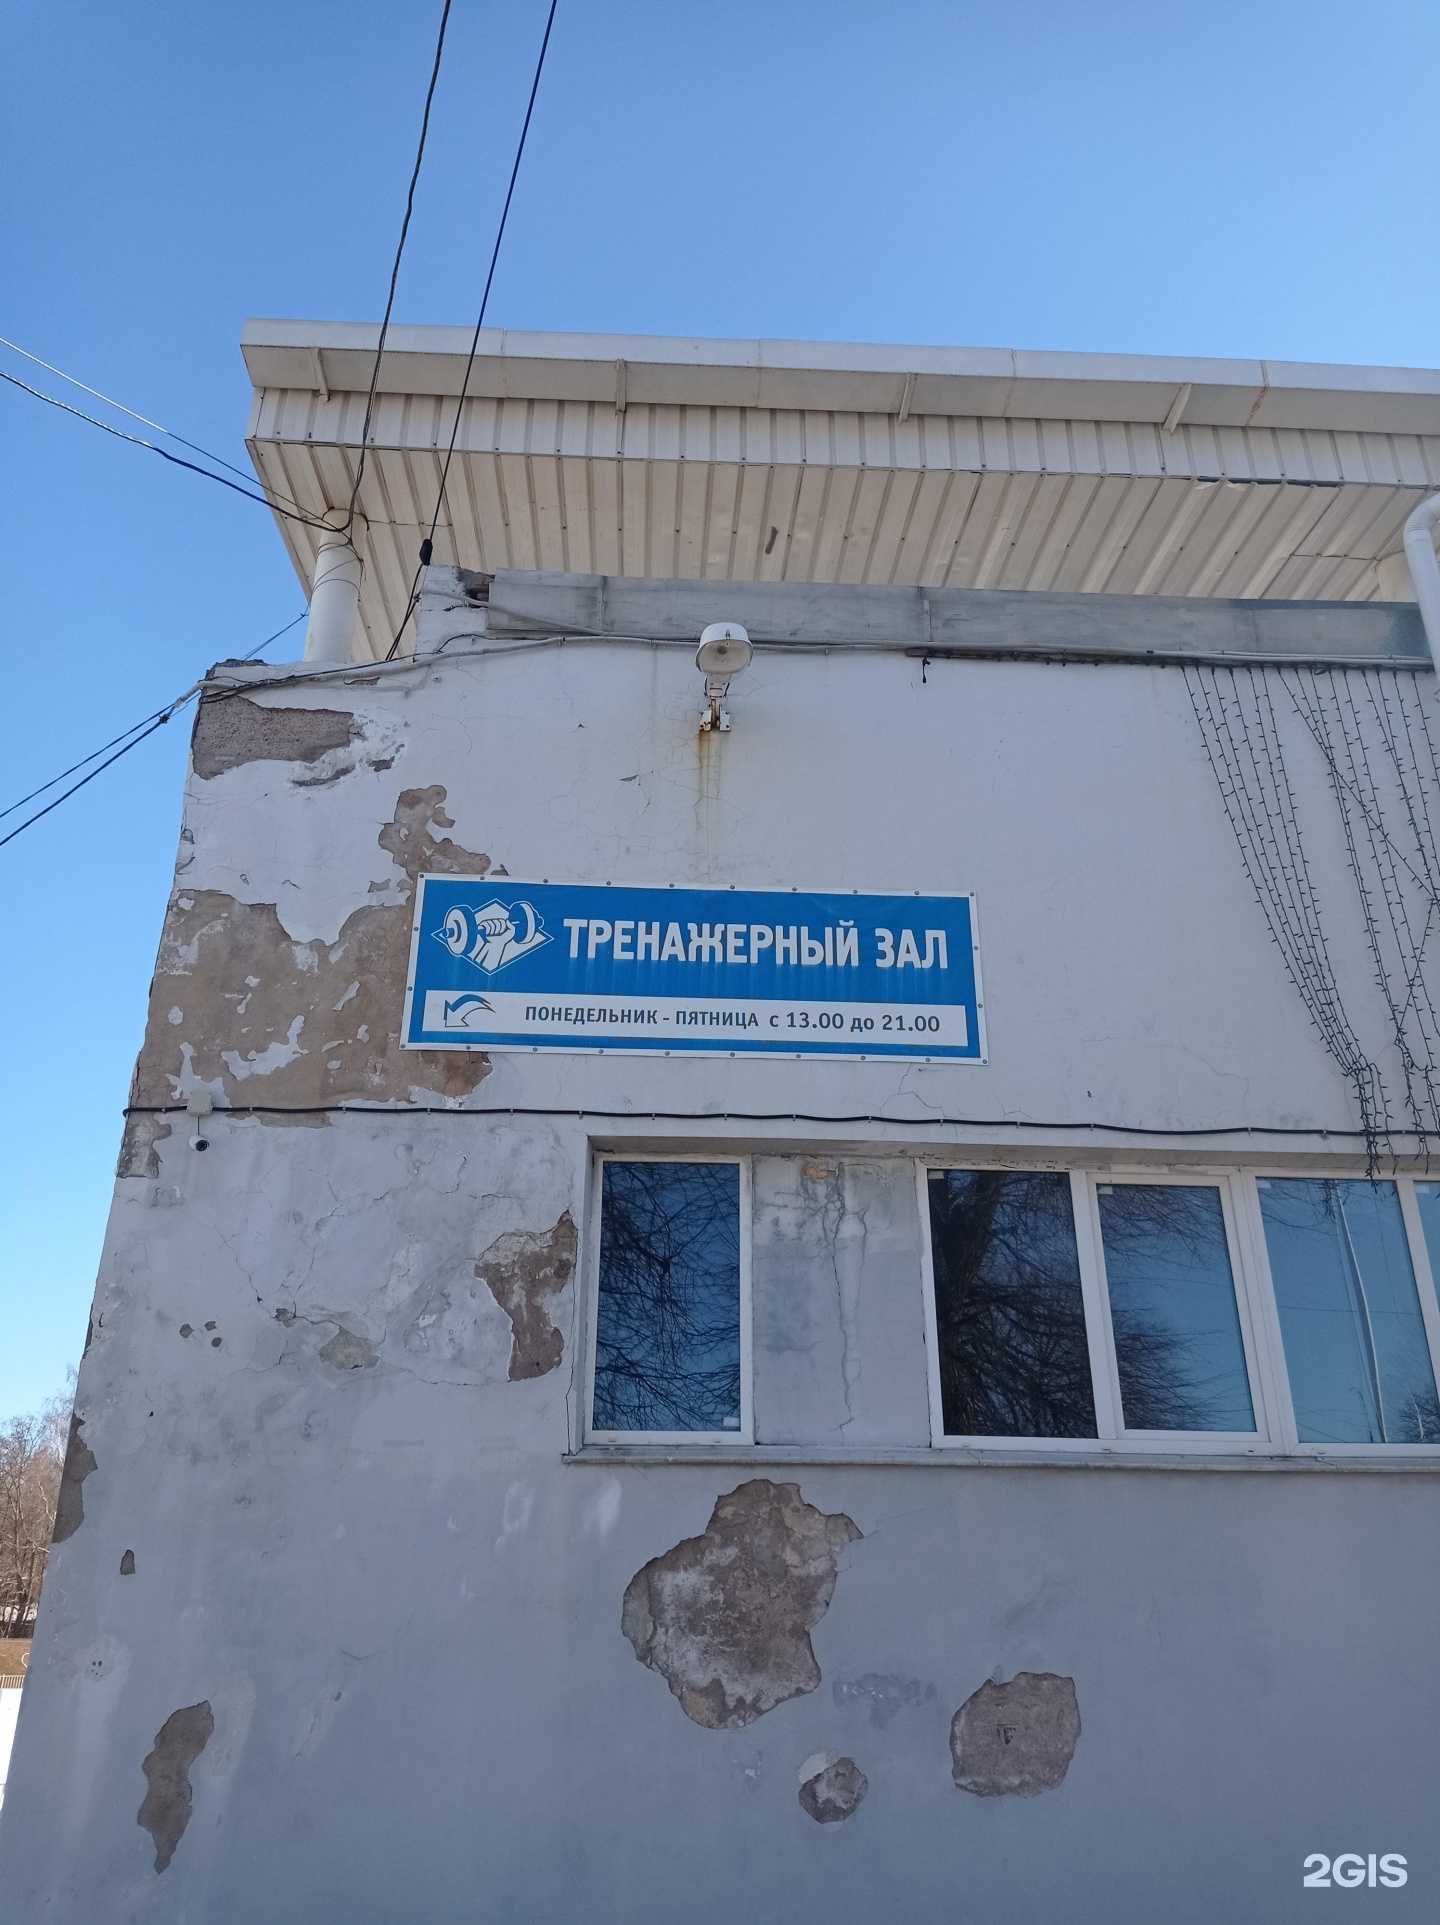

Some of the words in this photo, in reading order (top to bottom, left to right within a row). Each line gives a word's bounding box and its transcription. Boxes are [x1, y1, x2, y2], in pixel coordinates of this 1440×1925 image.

[563, 918, 859, 967] ТРЕНАЖЕРНЫЙ
[874, 927, 948, 969] ЗАЛ
[524, 1005, 658, 1025] ПОНЕДЕЛЬНИК
[675, 1010, 759, 1029] ПЯТНИЦА
[769, 1014, 779, 1028] с
[786, 1011, 844, 1030] 13.00
[850, 1017, 875, 1033] до
[881, 1014, 940, 1033] 21.00
